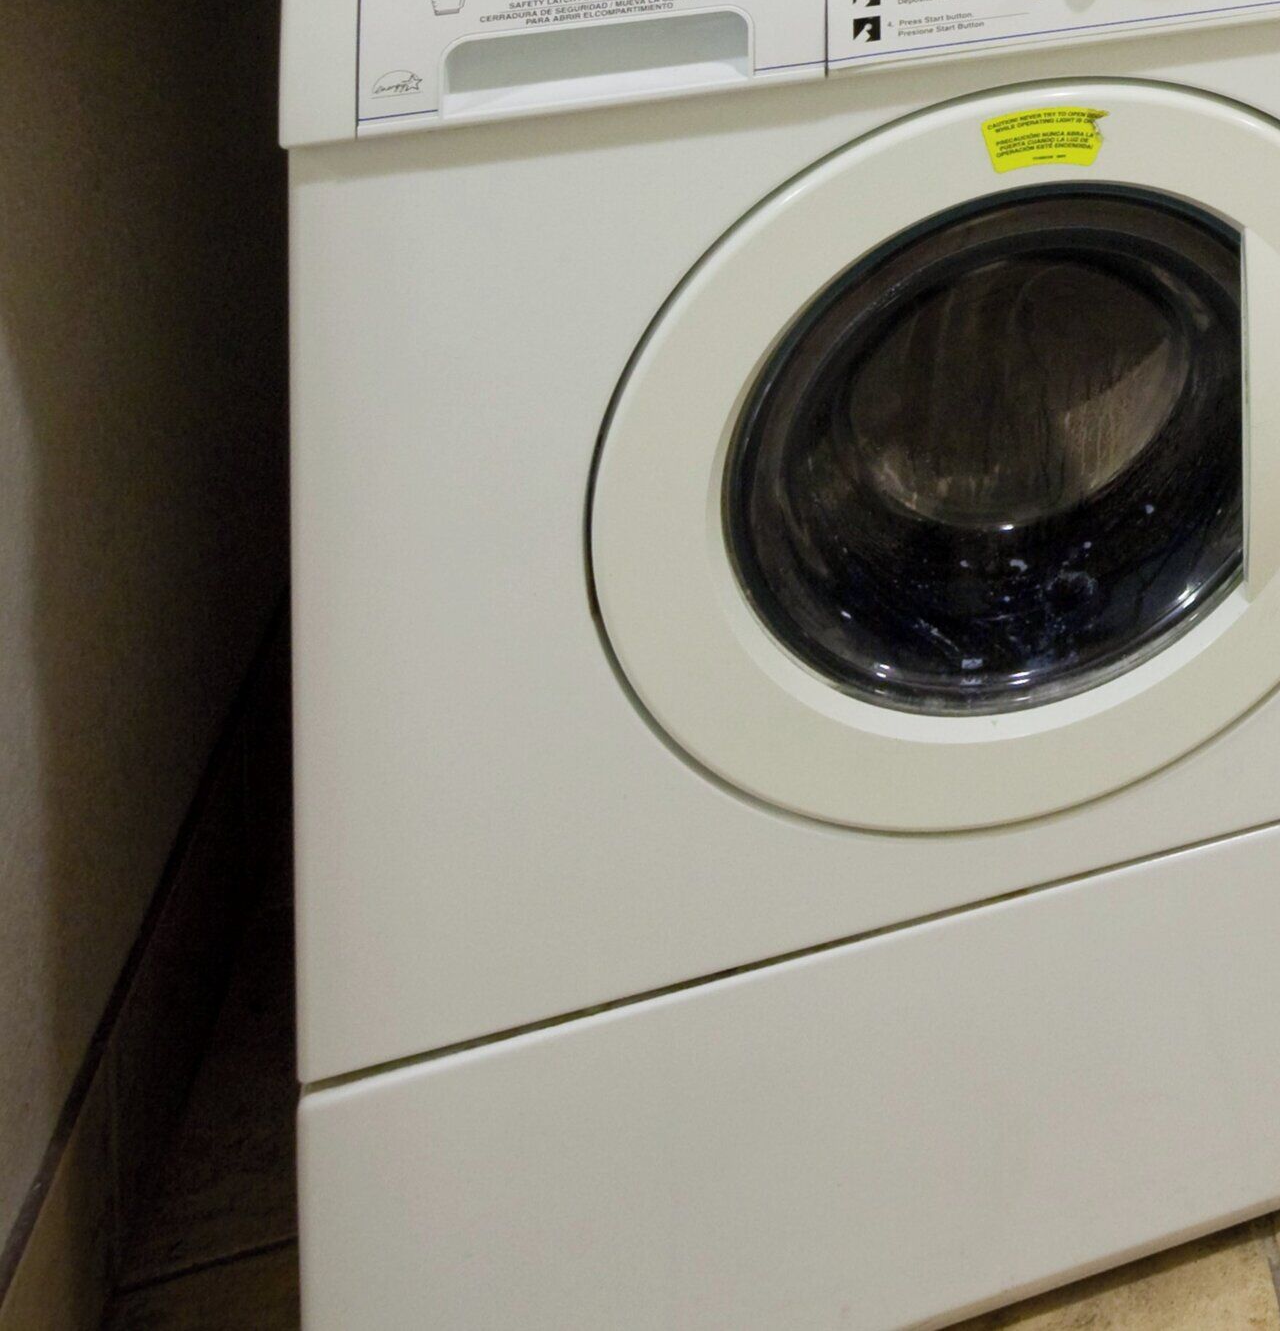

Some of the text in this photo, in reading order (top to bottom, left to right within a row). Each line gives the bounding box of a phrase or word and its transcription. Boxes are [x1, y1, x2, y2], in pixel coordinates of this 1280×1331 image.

[509, 0, 544, 9] SAFETY
[480, 11, 538, 23] CERRADURA
[555, 2, 608, 14] SEGURIDAD
